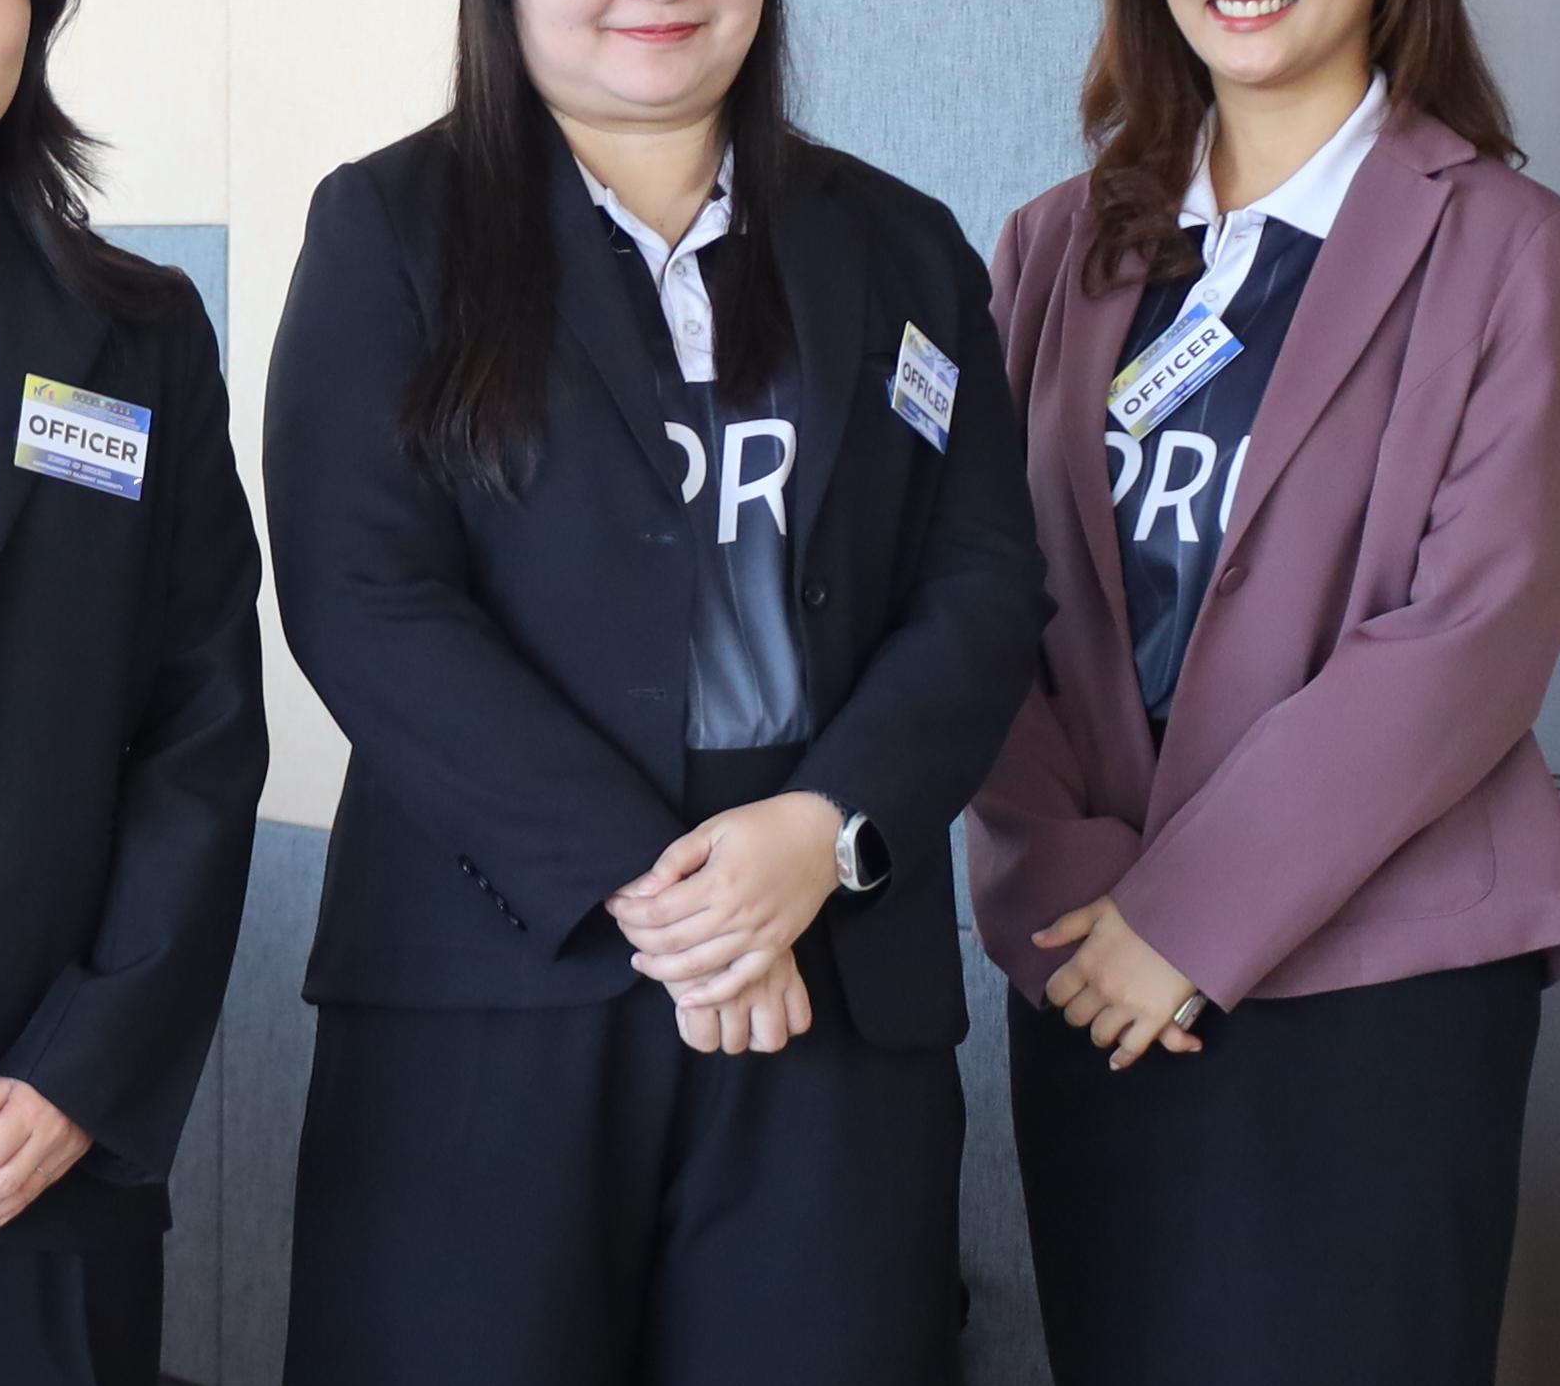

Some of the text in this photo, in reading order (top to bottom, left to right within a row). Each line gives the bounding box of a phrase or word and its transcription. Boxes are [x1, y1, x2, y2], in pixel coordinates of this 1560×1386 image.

[902, 361, 949, 419] OFFICER
[1124, 328, 1220, 415] OFFICER
[29, 414, 138, 464] OFFICER
